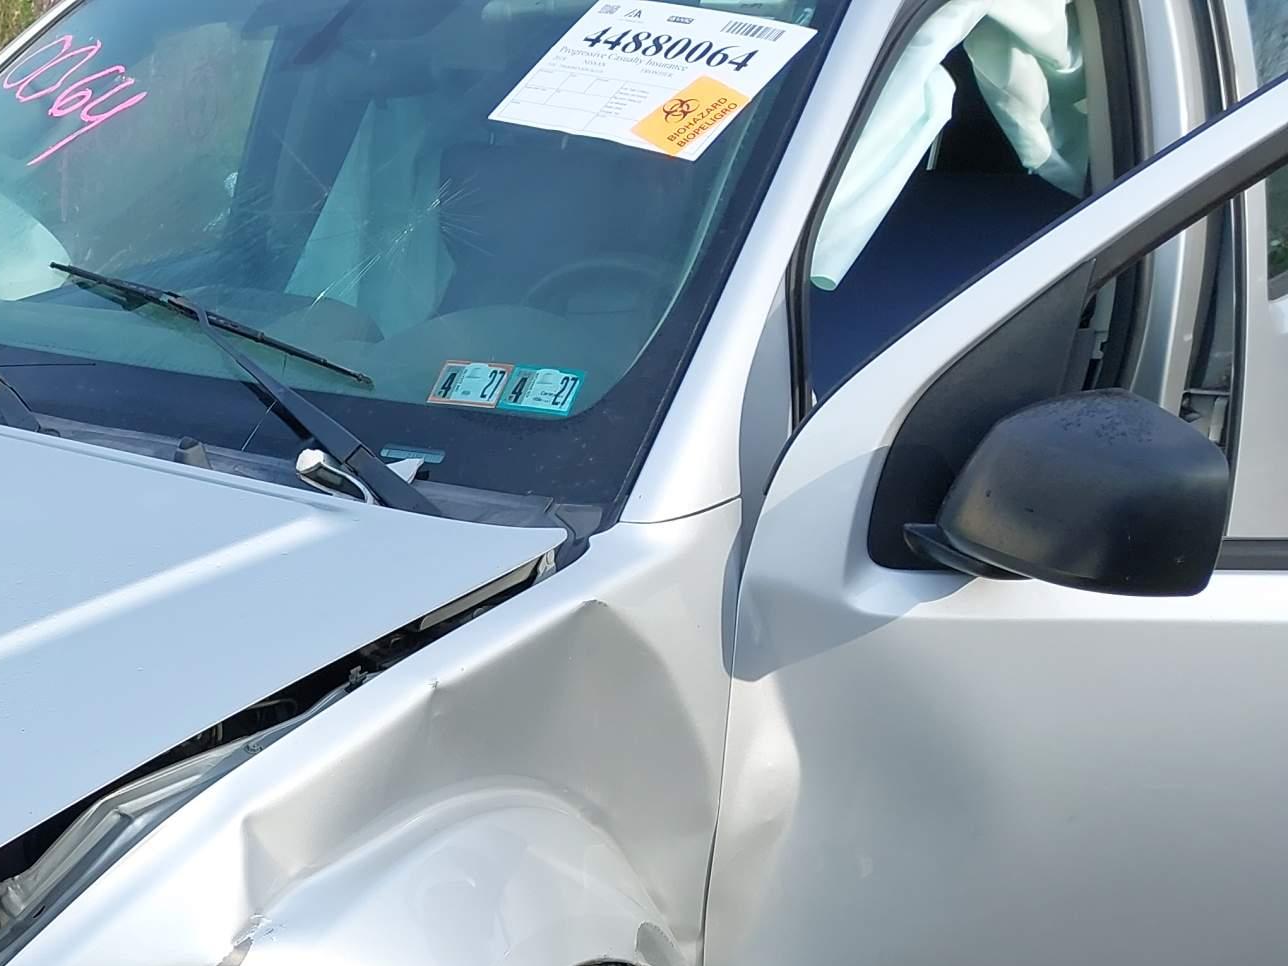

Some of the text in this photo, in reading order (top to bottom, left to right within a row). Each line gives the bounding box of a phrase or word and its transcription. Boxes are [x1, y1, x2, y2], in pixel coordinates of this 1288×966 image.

[559, 46, 608, 60] Progressive
[608, 53, 642, 65] Casualty
[646, 59, 689, 72] Insurance
[583, 26, 759, 72] 44880064
[3, 35, 148, 166] 0064
[666, 97, 728, 143] BIOHAZARD
[676, 102, 738, 148] BIOPELIGRO
[440, 372, 457, 398] 4
[480, 370, 506, 401] 27
[509, 377, 528, 403] 4
[551, 376, 579, 407] 27
